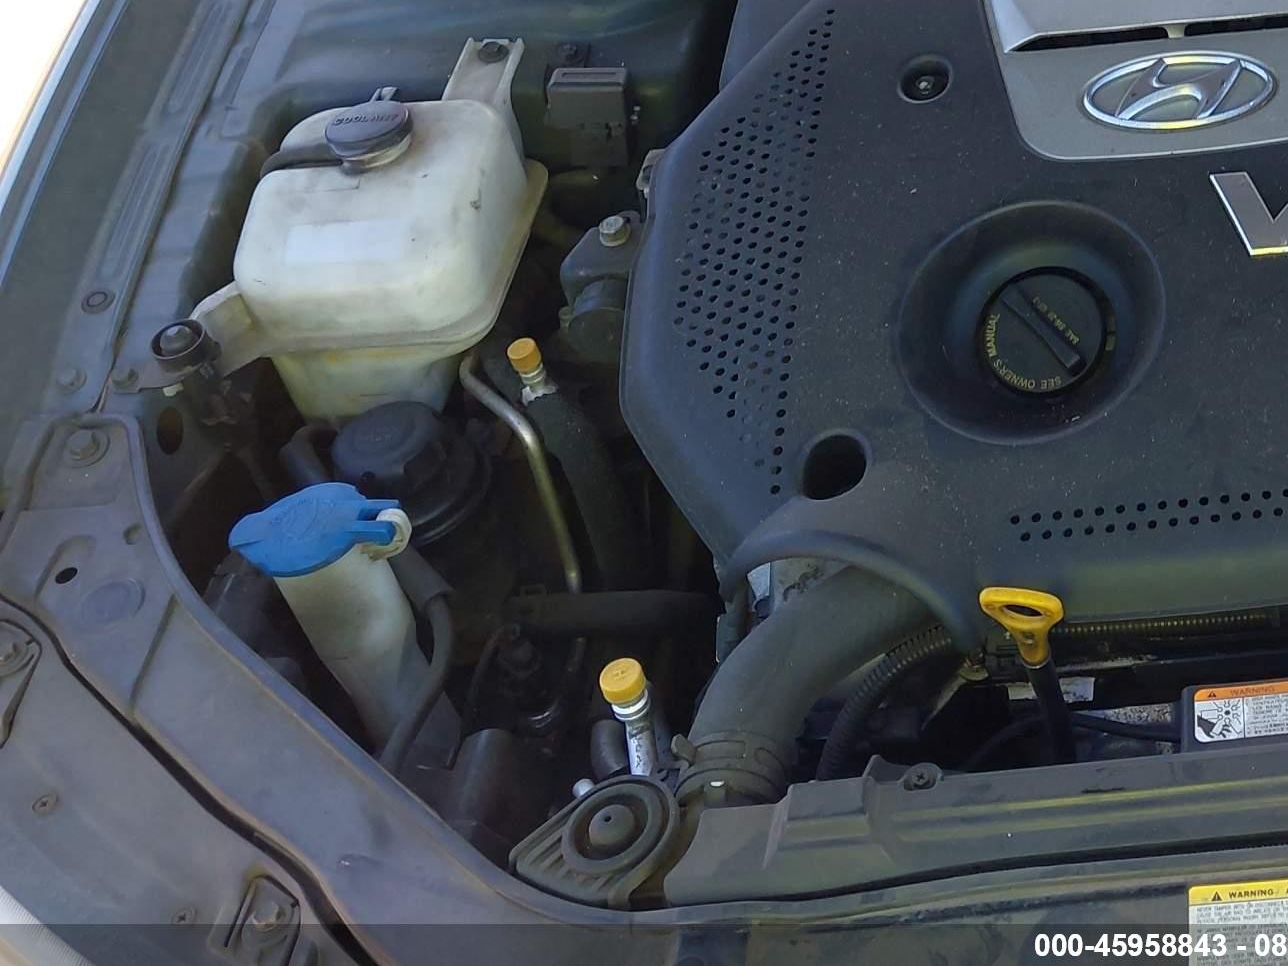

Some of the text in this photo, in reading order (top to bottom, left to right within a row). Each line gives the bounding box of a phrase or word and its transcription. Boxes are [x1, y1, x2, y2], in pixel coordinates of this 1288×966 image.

[984, 313, 1000, 358] MANUAL
[1040, 376, 1062, 390] SEE
[1230, 686, 1276, 696] WARNING
[1228, 888, 1275, 899] WARNING
